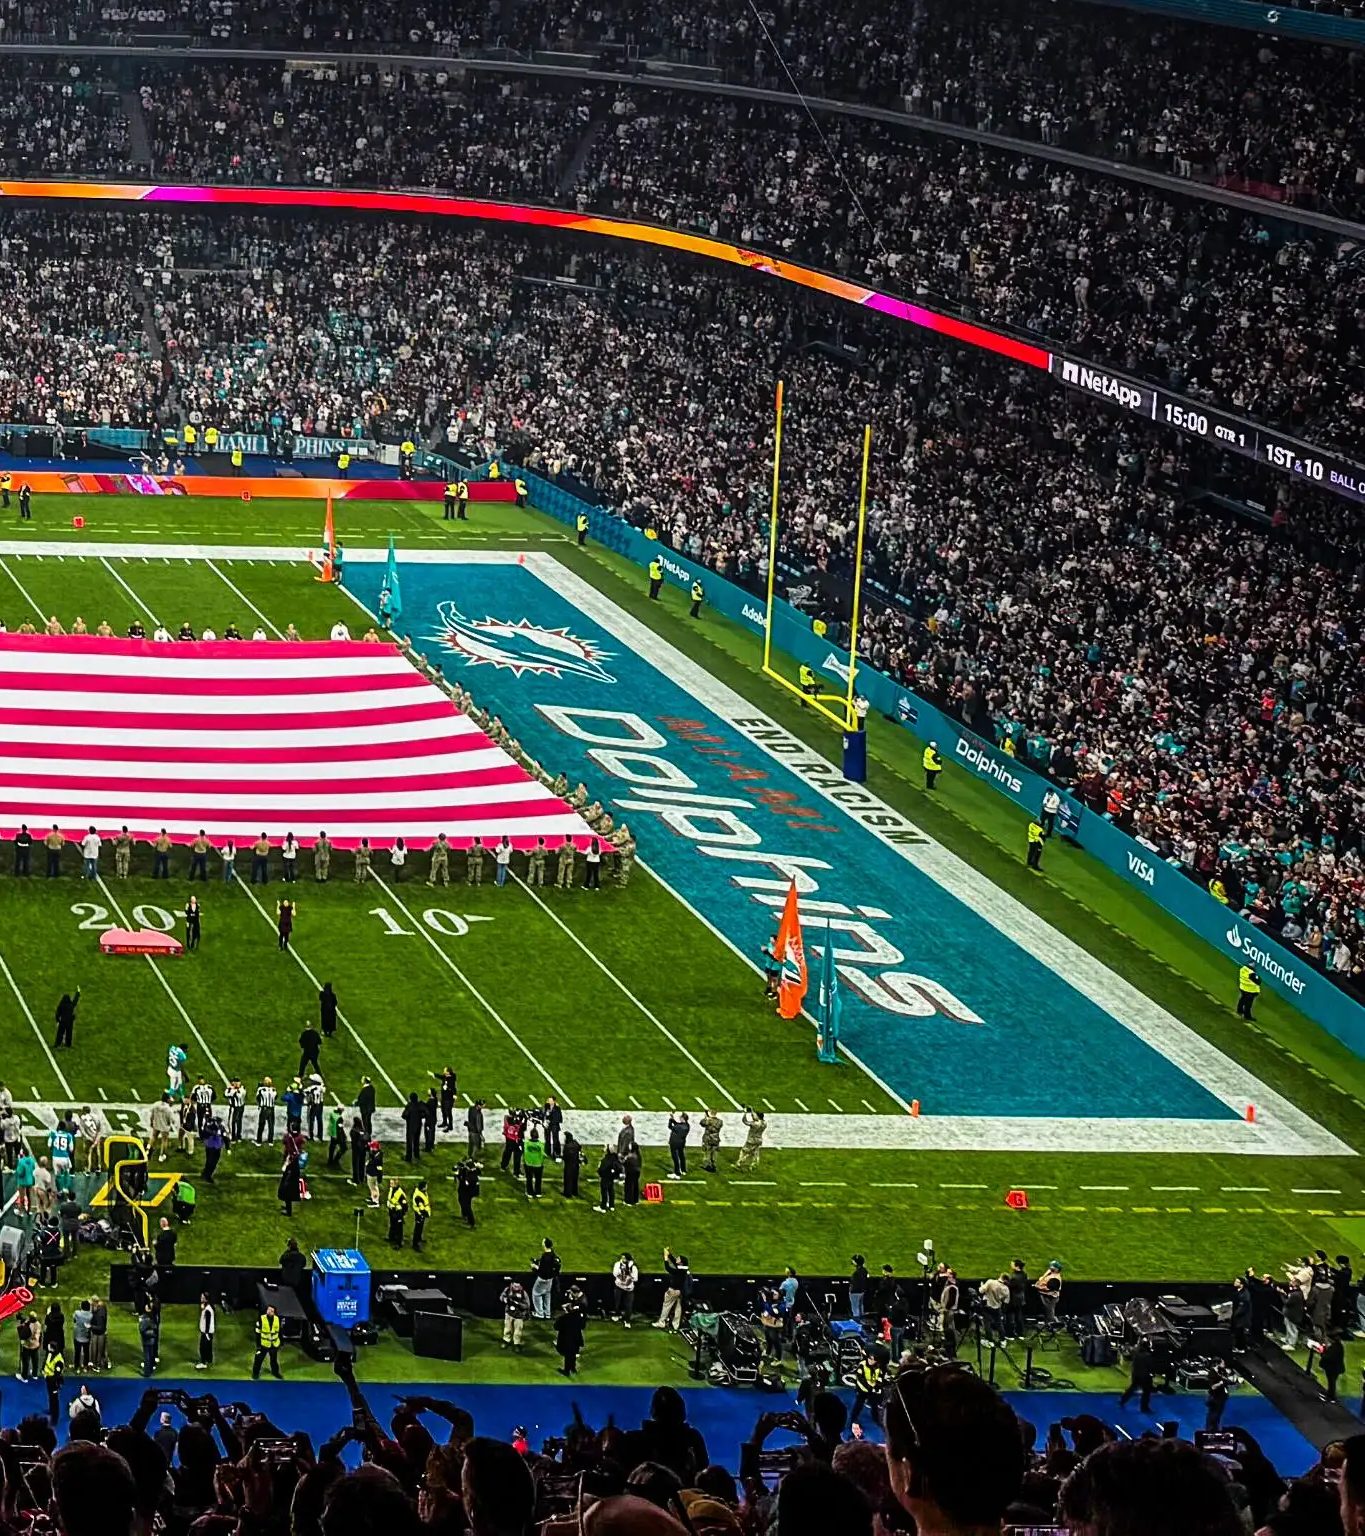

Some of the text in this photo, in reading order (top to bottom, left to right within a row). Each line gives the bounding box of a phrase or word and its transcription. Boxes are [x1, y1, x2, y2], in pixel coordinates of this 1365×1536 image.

[1080, 367, 1142, 409] NetApp
[1164, 403, 1245, 447] 15:00 QTR 1
[1266, 443, 1296, 469] 1ST
[1304, 459, 1324, 481] 10
[1330, 470, 1358, 491] BALL
[663, 557, 690, 582] NetApp
[657, 715, 841, 832] MIAMI
[730, 717, 931, 847] END RACISM
[955, 737, 1023, 794] Dolphins
[1127, 851, 1156, 887] VISA
[69, 901, 185, 931] 20
[368, 907, 471, 938] 10
[1242, 937, 1307, 995] Santander
[53, 1136, 68, 1151] 49
